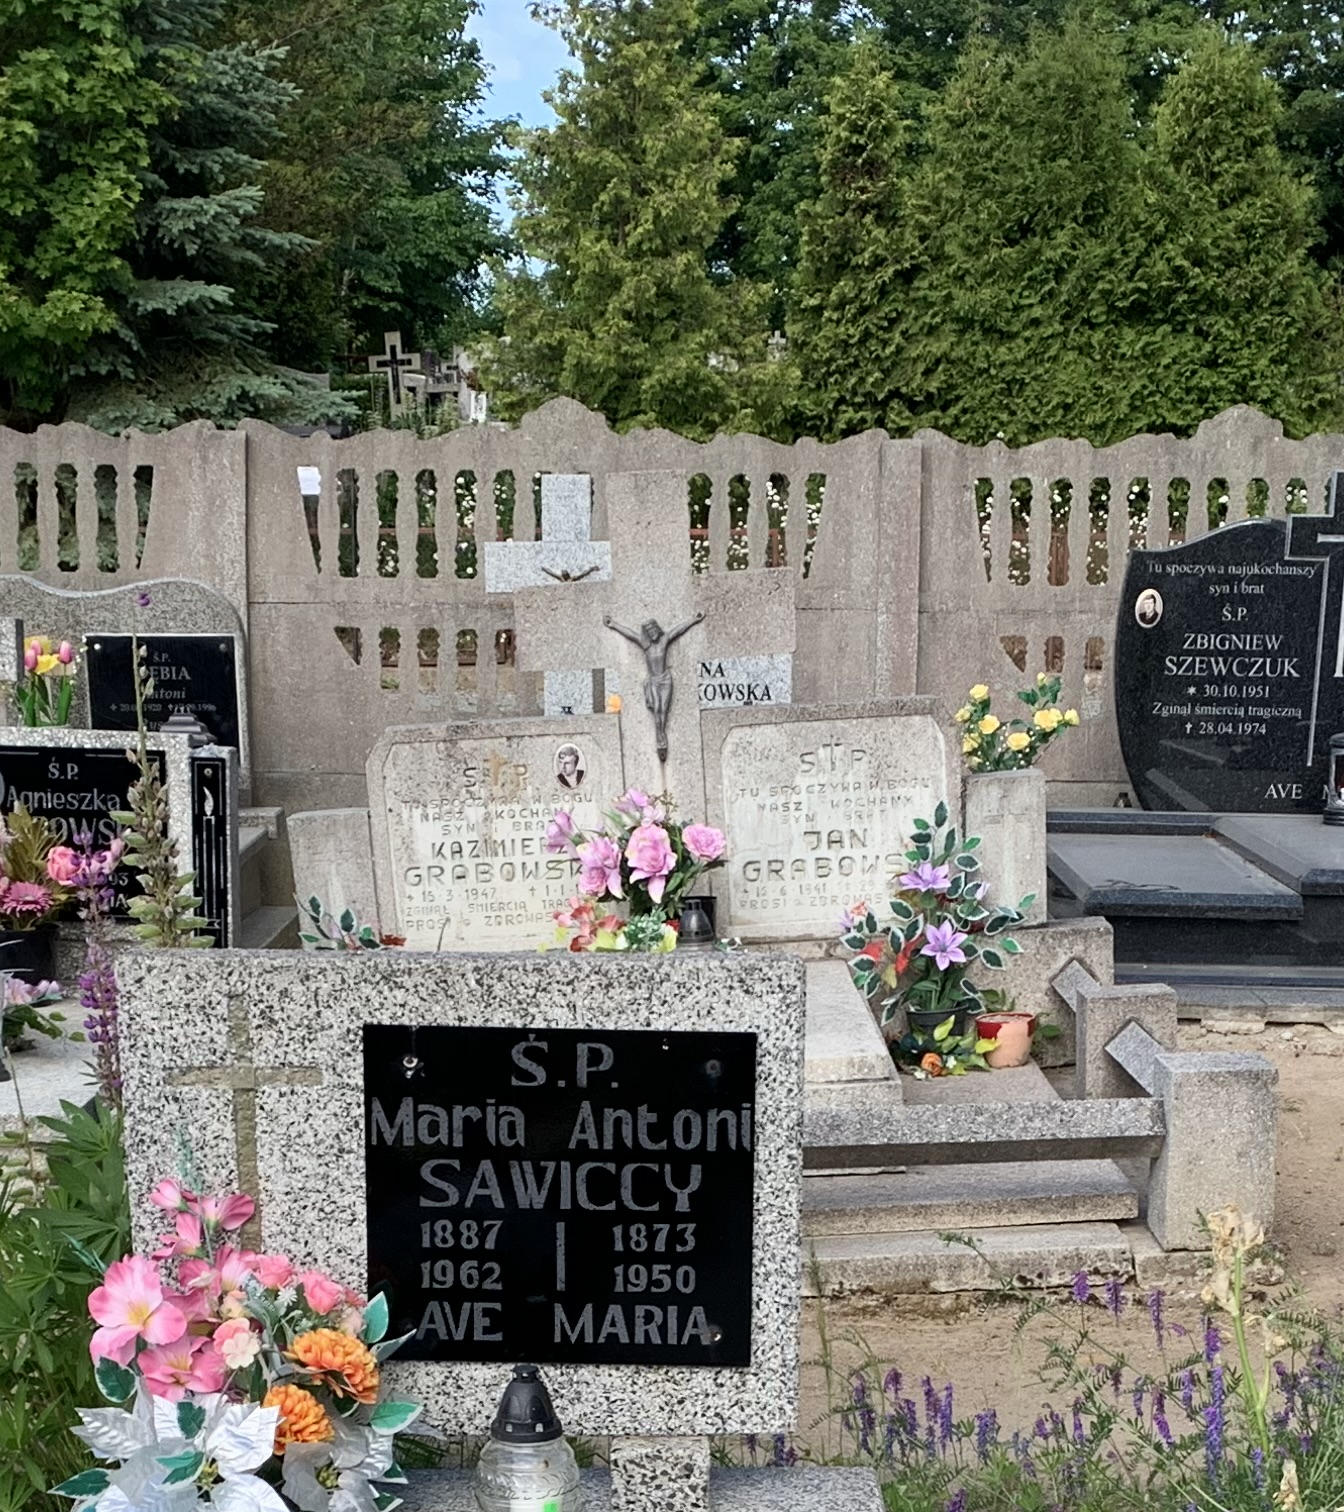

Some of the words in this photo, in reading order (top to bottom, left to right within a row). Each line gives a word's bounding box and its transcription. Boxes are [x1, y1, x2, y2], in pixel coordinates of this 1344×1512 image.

[1147, 560, 1162, 573] Tu
[1165, 562, 1225, 577] spoczywa
[1209, 585, 1230, 597] syn
[1241, 582, 1265, 595] brat
[1183, 632, 1283, 650] ZBIGNIEW
[1164, 655, 1301, 678] SZEWCZUK
[1202, 685, 1270, 698] 30.10.1951
[1152, 702, 1192, 716] Zginął
[1194, 702, 1245, 719] śmiercią
[1248, 704, 1302, 719] tragiczną
[1199, 721, 1267, 735] 28.04.1974
[47, 757, 79, 780] Ś.P.
[6, 785, 121, 813] Agnieszka
[1264, 784, 1303, 800] AVE
[420, 811, 465, 823] NASZ
[441, 823, 476, 837] SYN
[803, 827, 869, 851] JAN
[406, 859, 583, 887] GRABOWSK
[742, 852, 904, 883] GRABOWS
[511, 1033, 619, 1089] Ś.P.
[370, 1097, 526, 1150] Maria
[570, 1101, 753, 1154] Antoni
[418, 1159, 703, 1213] SAWICCY
[420, 1219, 504, 1251] 1887
[611, 1220, 697, 1254] 1873
[420, 1259, 504, 1291] 1962
[613, 1263, 697, 1295] 1950
[416, 1302, 504, 1342] AVE
[553, 1304, 711, 1347] MARIA
